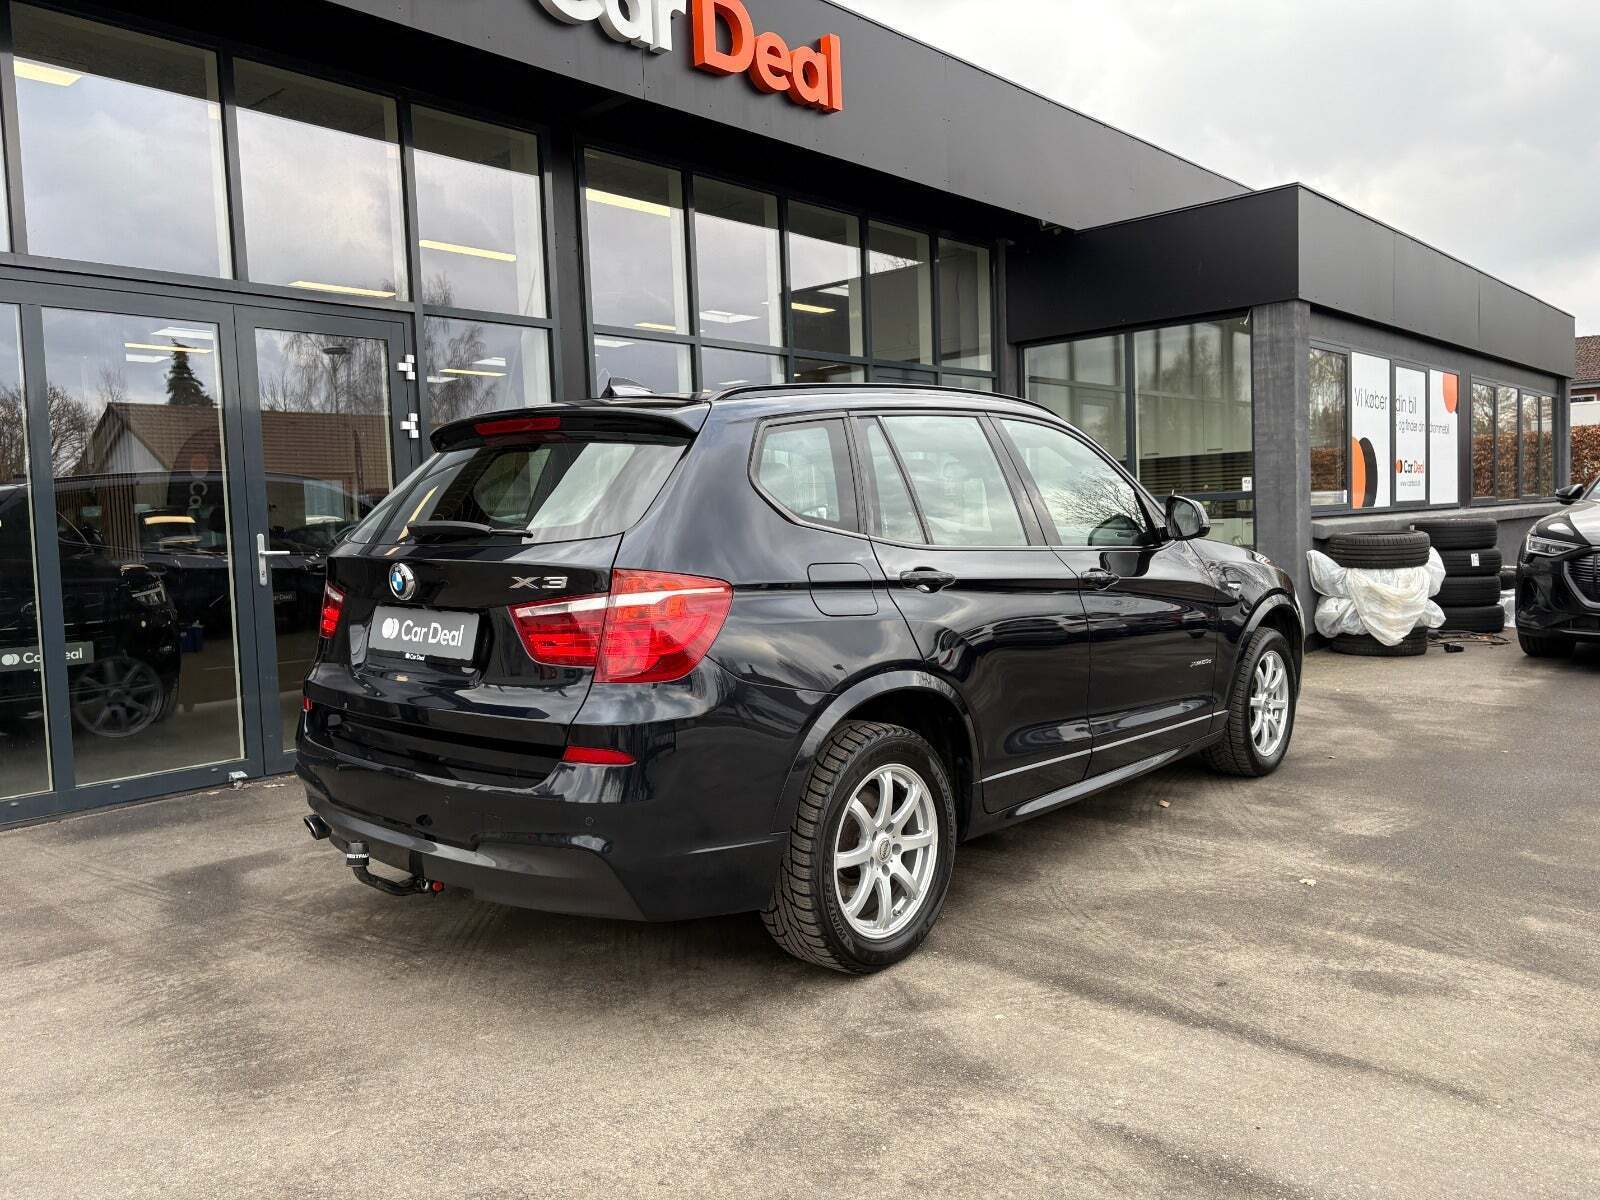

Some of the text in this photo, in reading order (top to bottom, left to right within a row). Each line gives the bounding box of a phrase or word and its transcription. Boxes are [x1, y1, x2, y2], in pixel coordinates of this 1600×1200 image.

[690, 0, 842, 113] Deal
[1354, 387, 1417, 414] Vi køber din bil
[1403, 459, 1413, 474] Car
[508, 576, 568, 590] X3
[401, 619, 465, 647] Car Deal
[65, 647, 83, 660] eal
